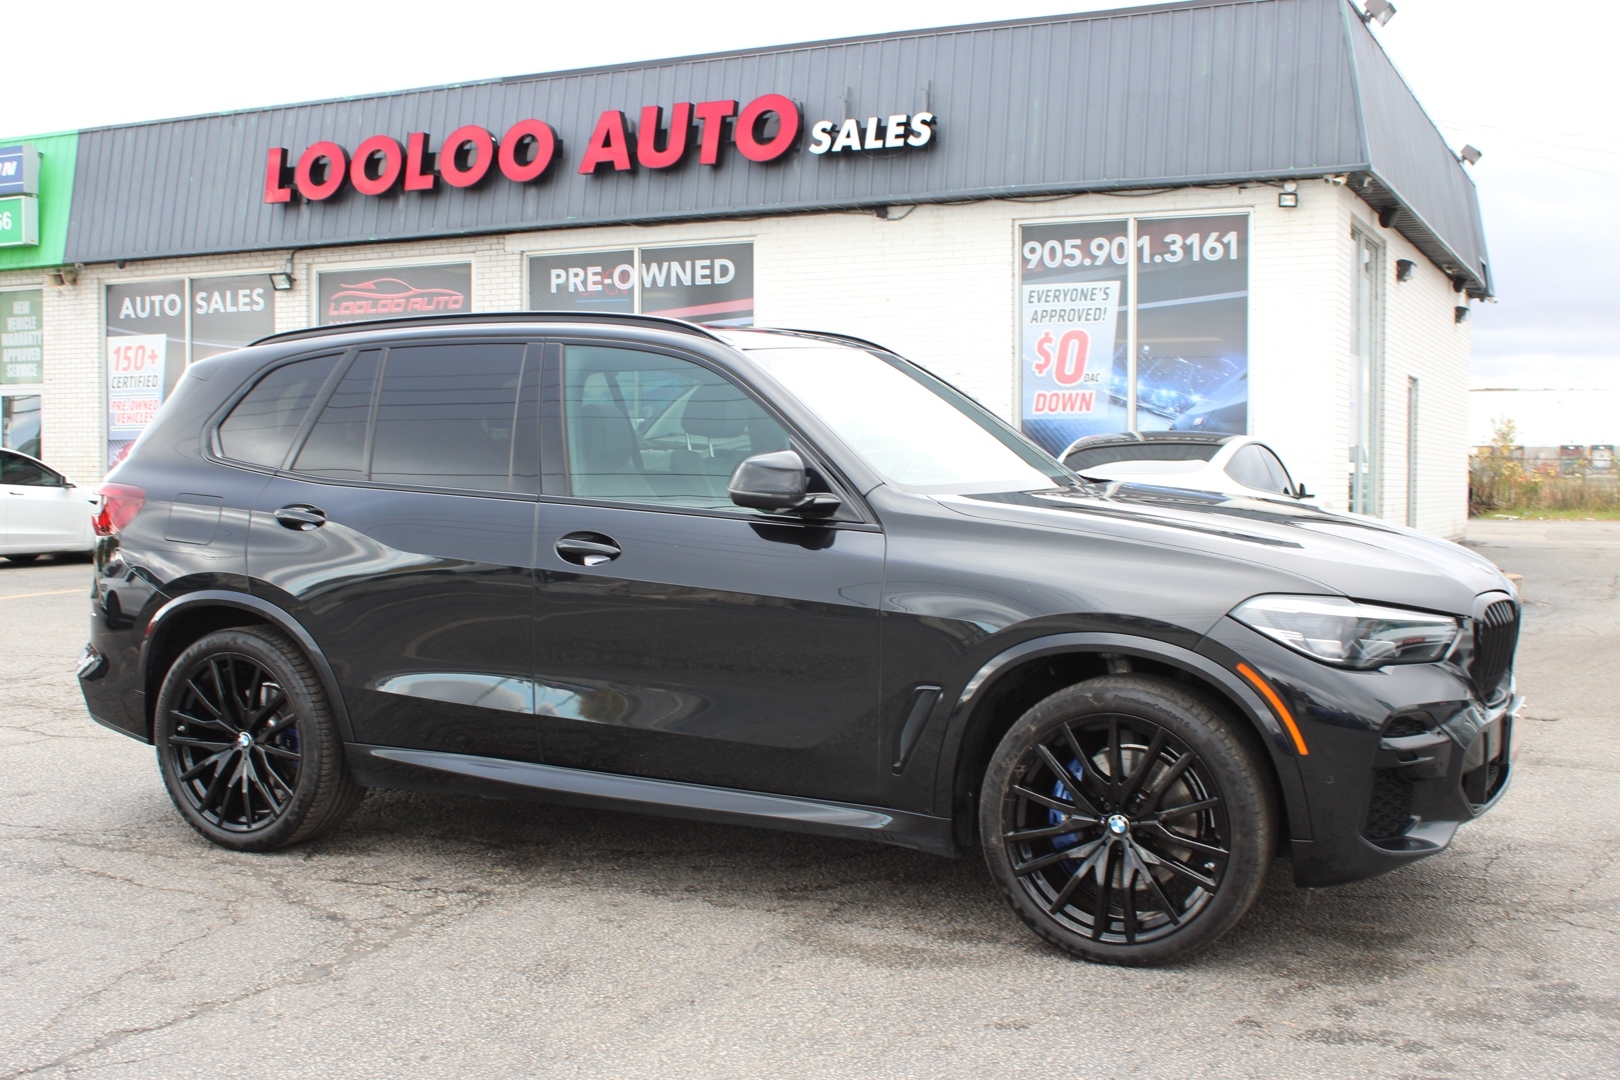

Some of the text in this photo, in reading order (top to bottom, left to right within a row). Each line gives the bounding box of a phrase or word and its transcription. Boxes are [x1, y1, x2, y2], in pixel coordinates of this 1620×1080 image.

[265, 93, 936, 204] LOOLOO AUTO SALES
[1022, 231, 1239, 269] 905.901.3161
[550, 258, 736, 294] PRE-OWNED
[119, 288, 266, 318] AUTO SALES
[1027, 286, 1111, 305] EVERYONE'S
[328, 295, 464, 316] LOOLOO AUTO
[6, 316, 37, 331] VEHICLE
[1030, 306, 1108, 325] APPROVED!
[1, 331, 43, 347] WARRANTY
[3, 347, 41, 362] APPROVED
[113, 344, 159, 372] 150+
[1035, 330, 1101, 385] $0 OAC
[6, 363, 38, 378] SERVICE
[111, 374, 159, 389] CERTIFIED
[110, 399, 159, 412] PRE-OWNED
[1034, 392, 1093, 412] DOWN
